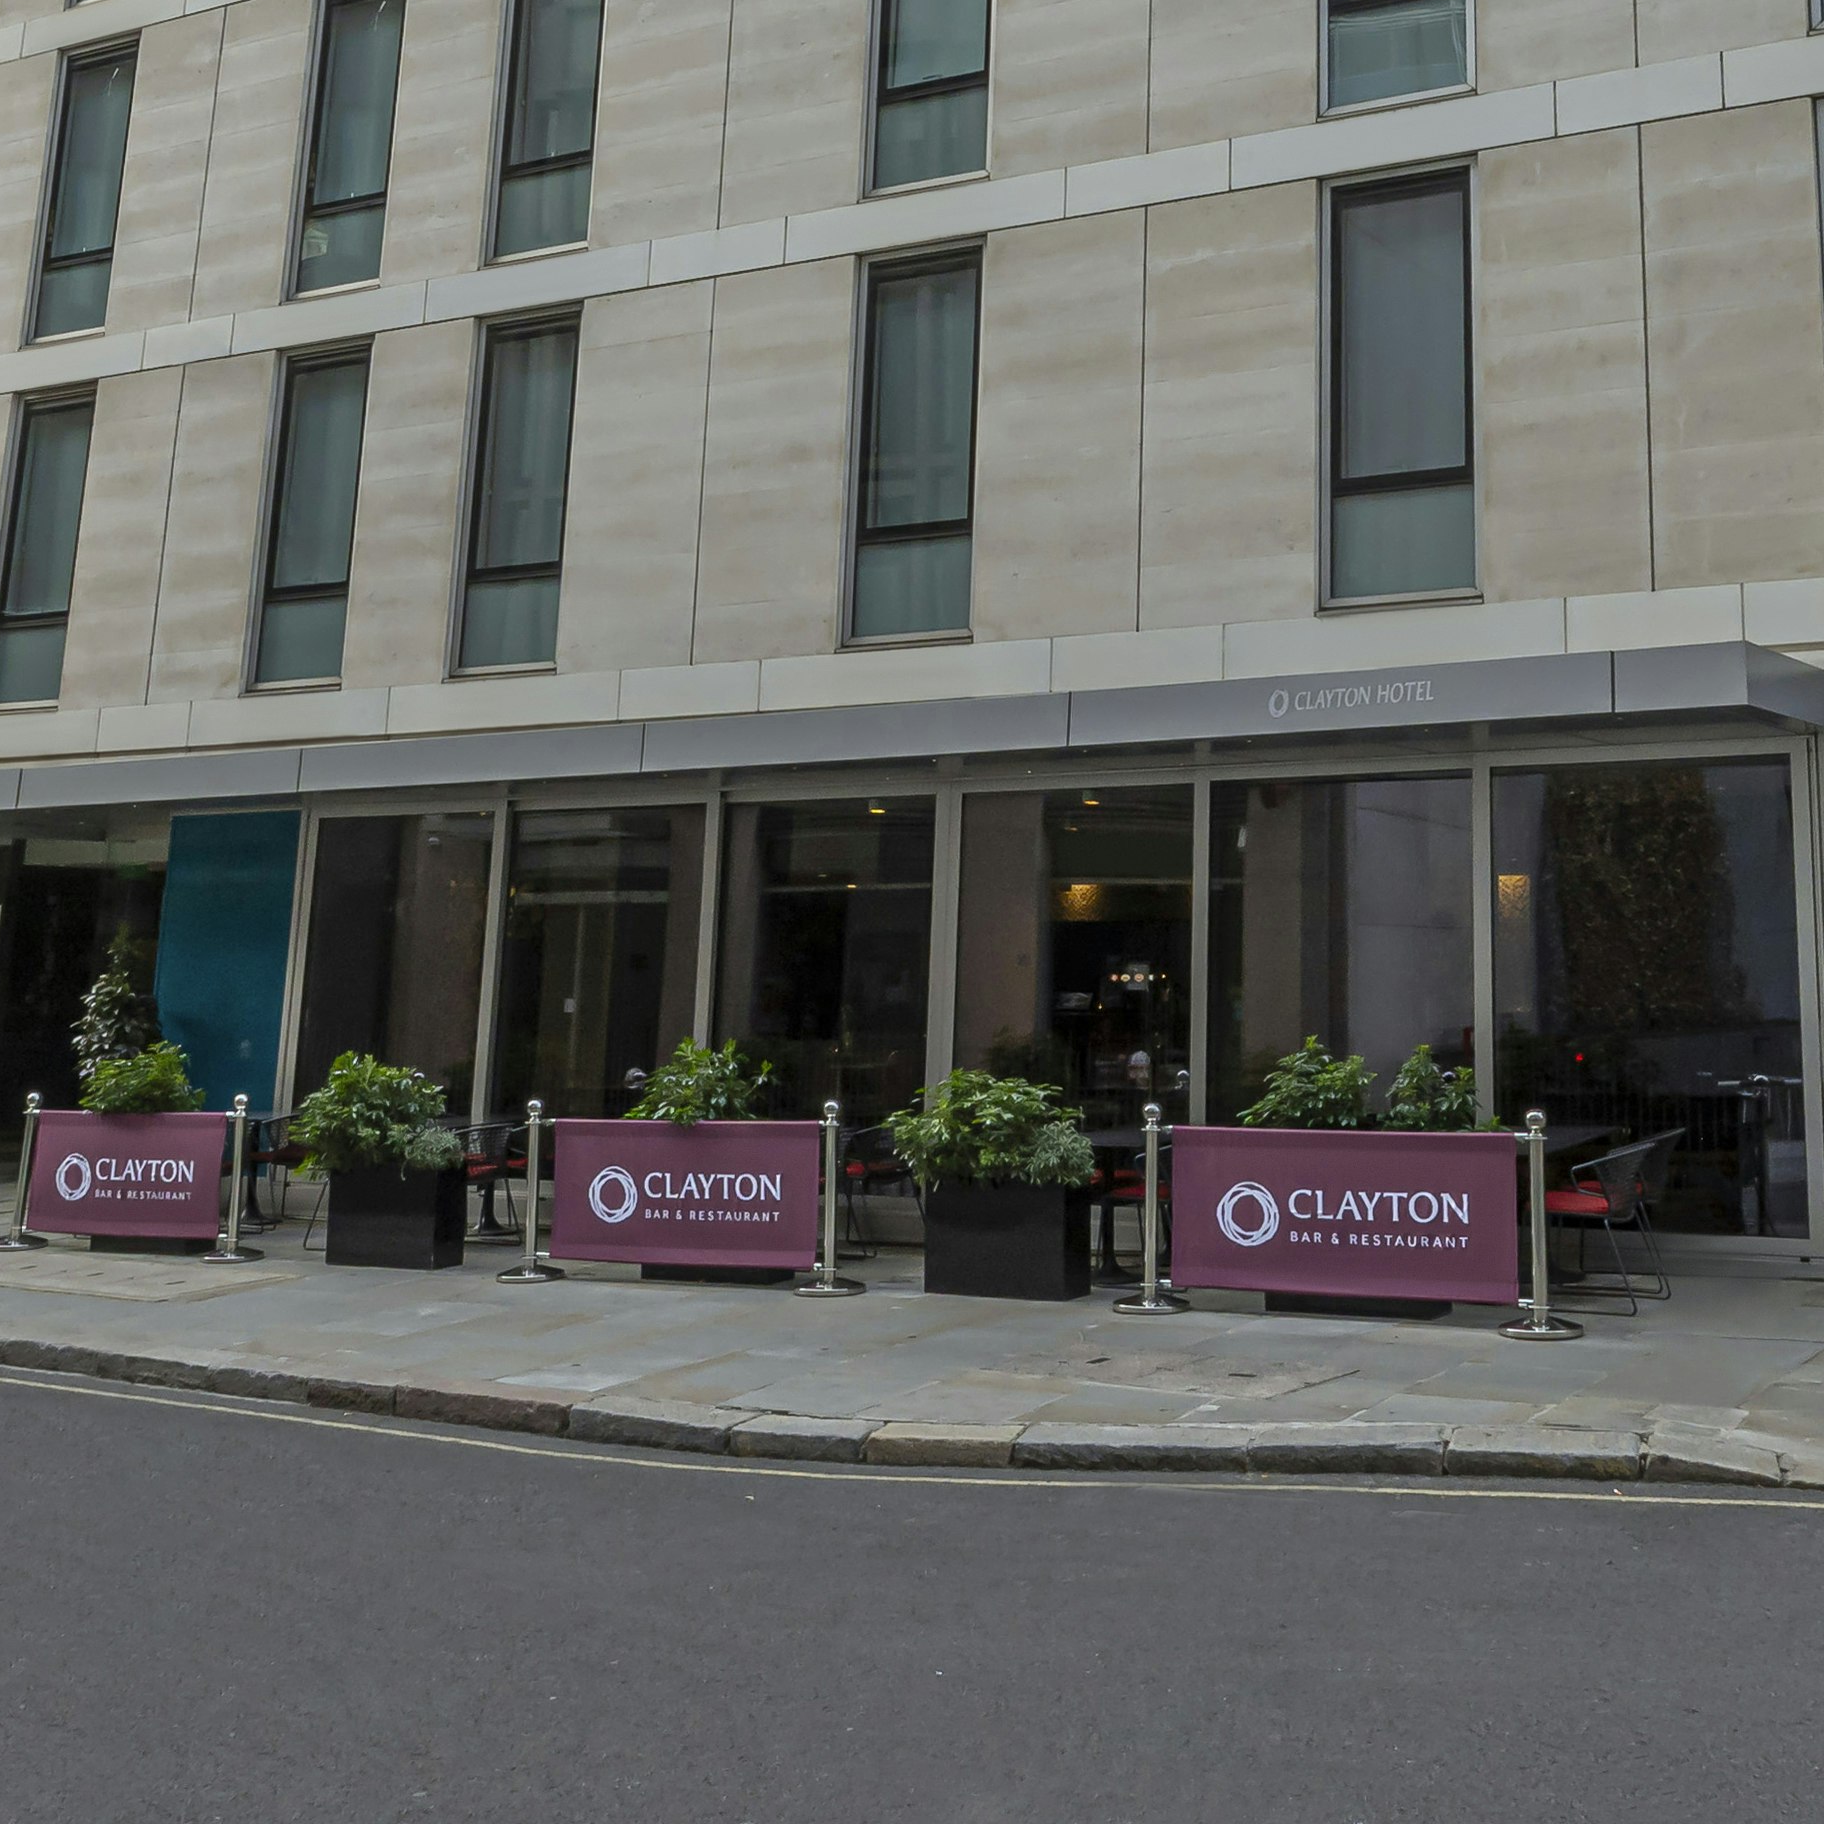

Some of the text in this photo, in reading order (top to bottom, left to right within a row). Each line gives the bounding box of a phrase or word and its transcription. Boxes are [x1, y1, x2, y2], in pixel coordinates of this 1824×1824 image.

[1294, 680, 1434, 711] CLAYTON HOTEL
[95, 1158, 194, 1183] CLAYTON
[94, 1188, 112, 1199] BAR
[127, 1190, 192, 1201] RESTAURANT
[644, 1172, 781, 1201] CLAYTON
[645, 1208, 780, 1222] BAR & RESTAURANT
[1288, 1189, 1469, 1224] CLAYTON
[1289, 1231, 1469, 1249] BAR & RESTAURANT
